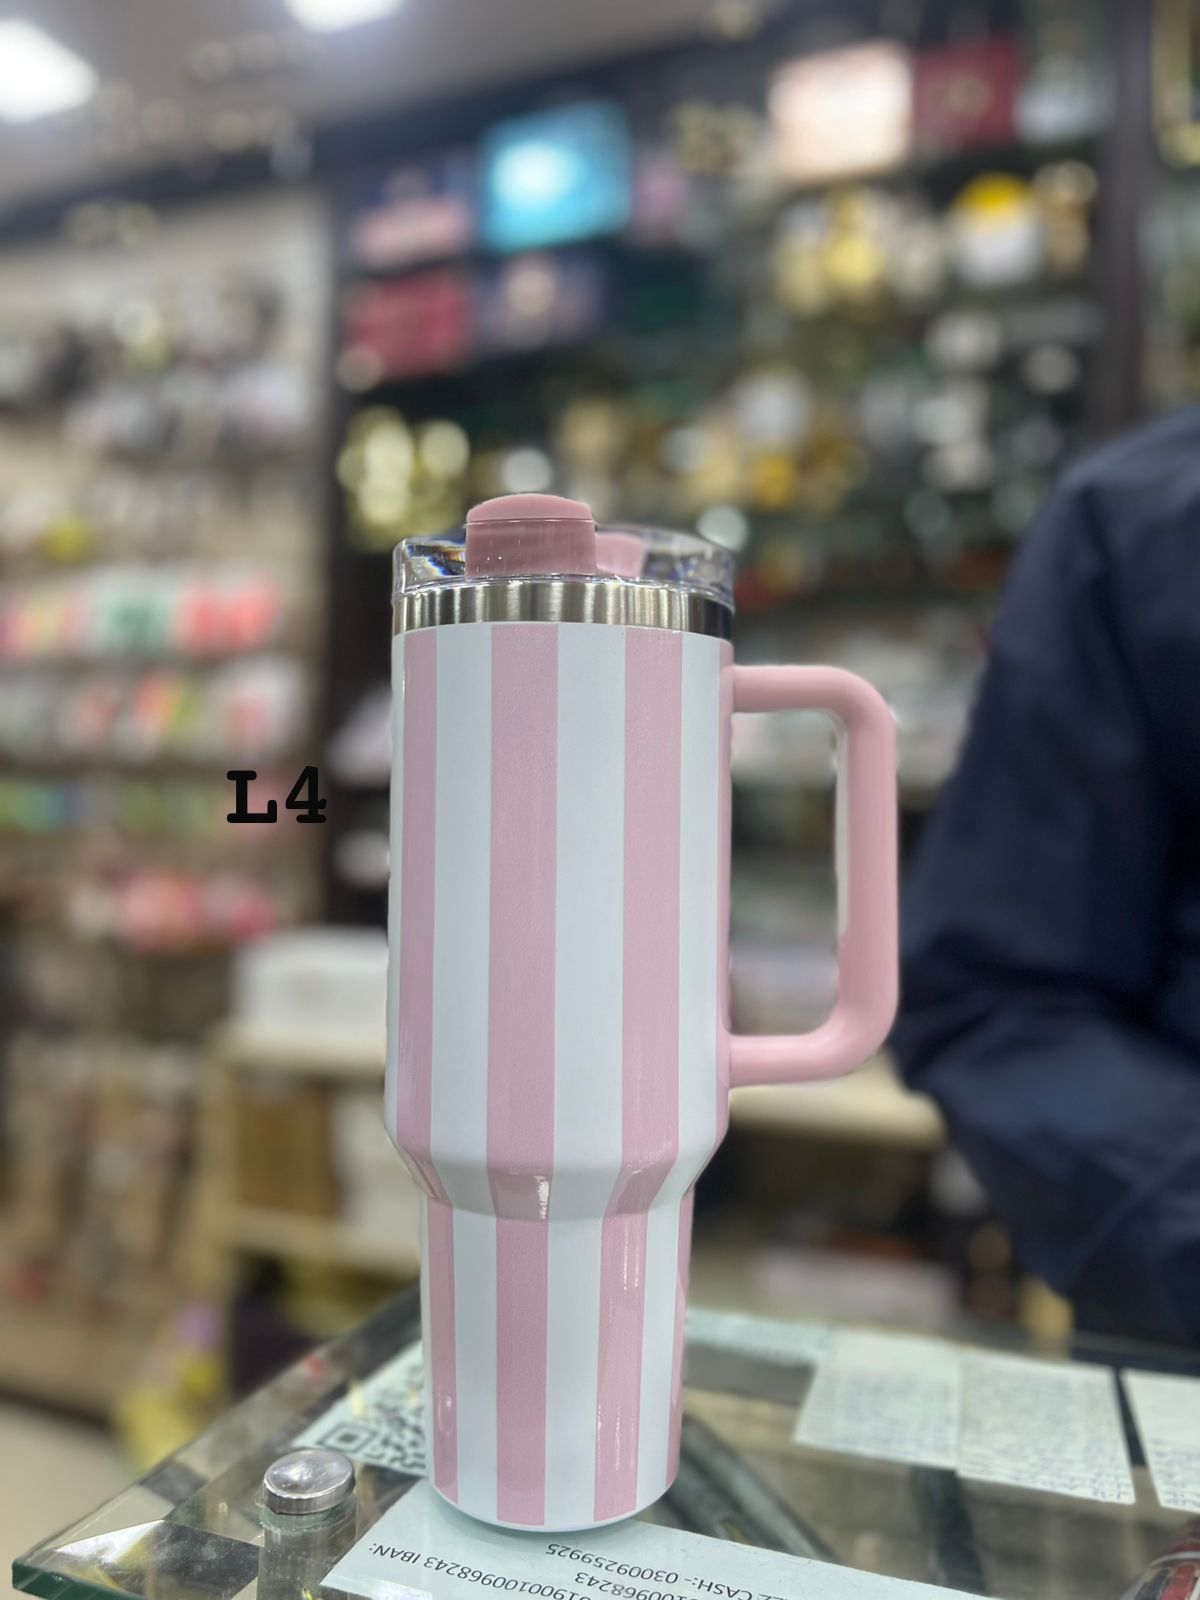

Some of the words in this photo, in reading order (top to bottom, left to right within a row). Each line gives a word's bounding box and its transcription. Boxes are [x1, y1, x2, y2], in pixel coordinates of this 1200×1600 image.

[369, 1543, 421, 1564] IBAN:
[545, 1543, 679, 1584] 03009259925
[575, 1572, 698, 1600] 00968243
